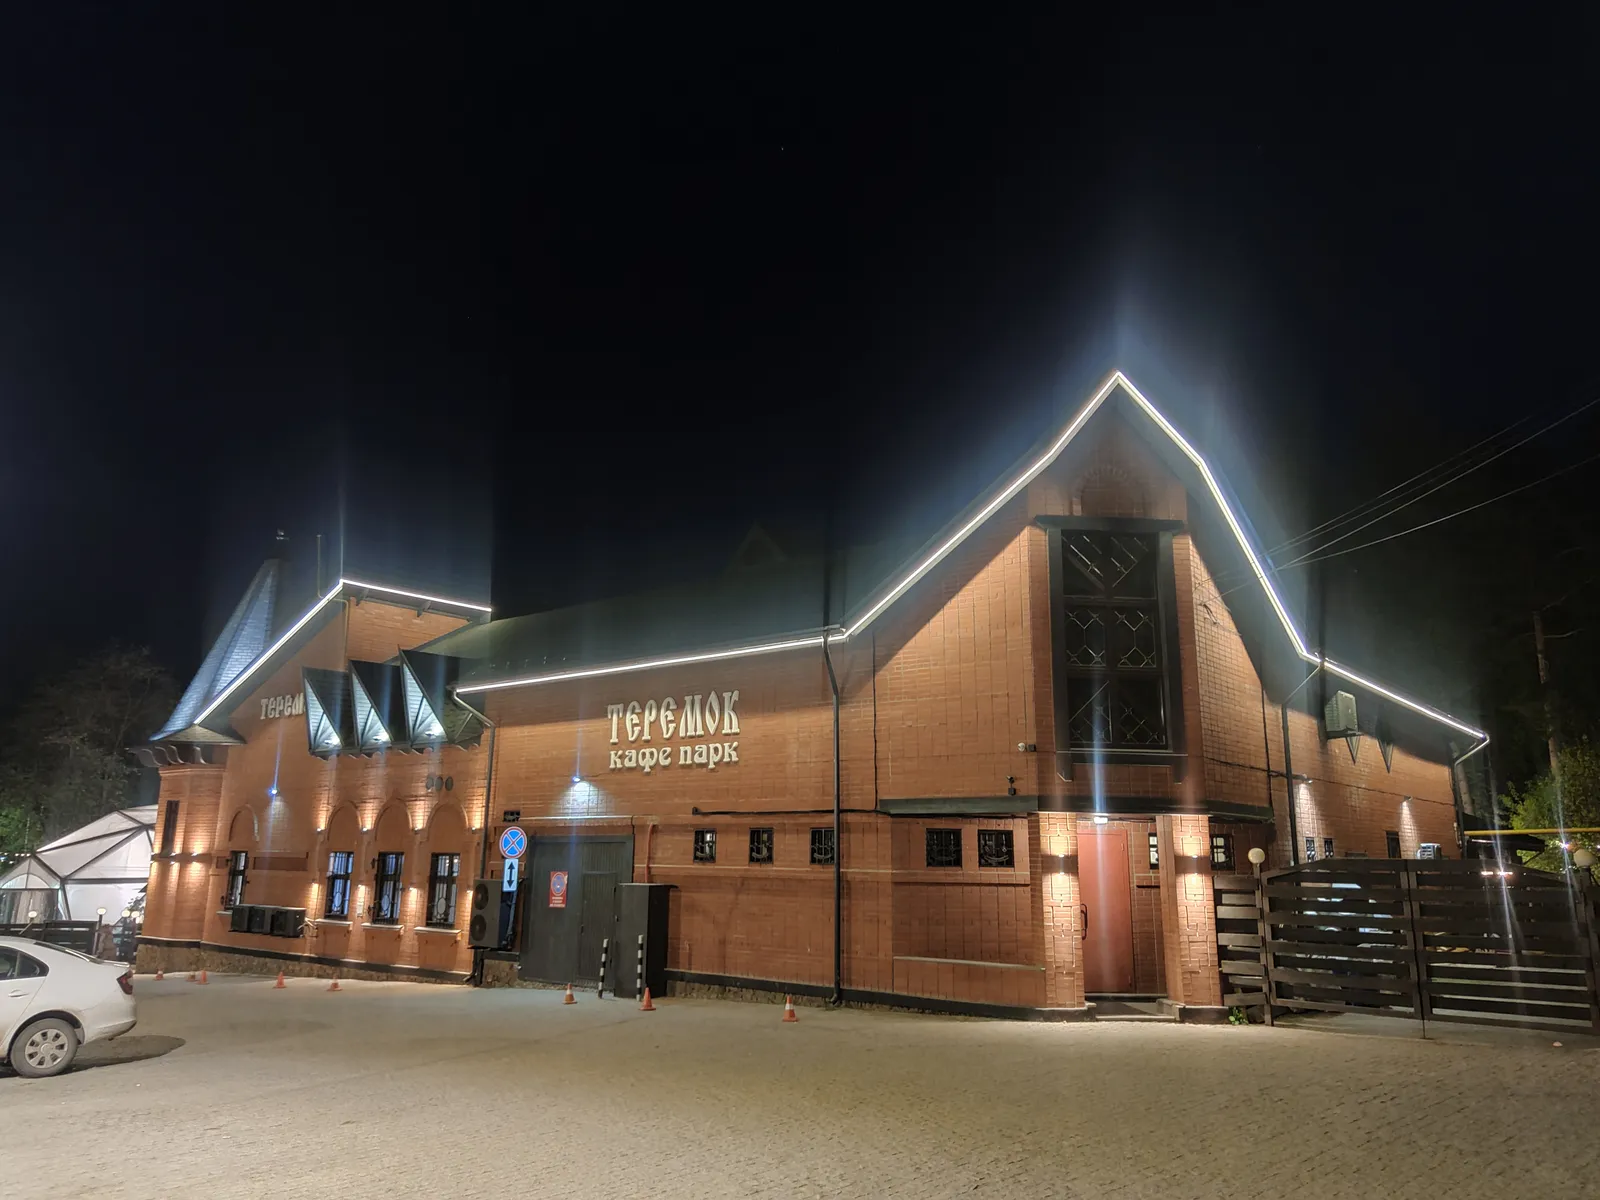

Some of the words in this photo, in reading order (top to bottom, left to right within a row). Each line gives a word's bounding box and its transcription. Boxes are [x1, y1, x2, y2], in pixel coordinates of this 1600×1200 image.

[260, 692, 306, 720] ТЕРЕМ
[607, 689, 741, 745] ТЕРЕМОК
[609, 747, 672, 773] кафе
[678, 741, 739, 769] парк
